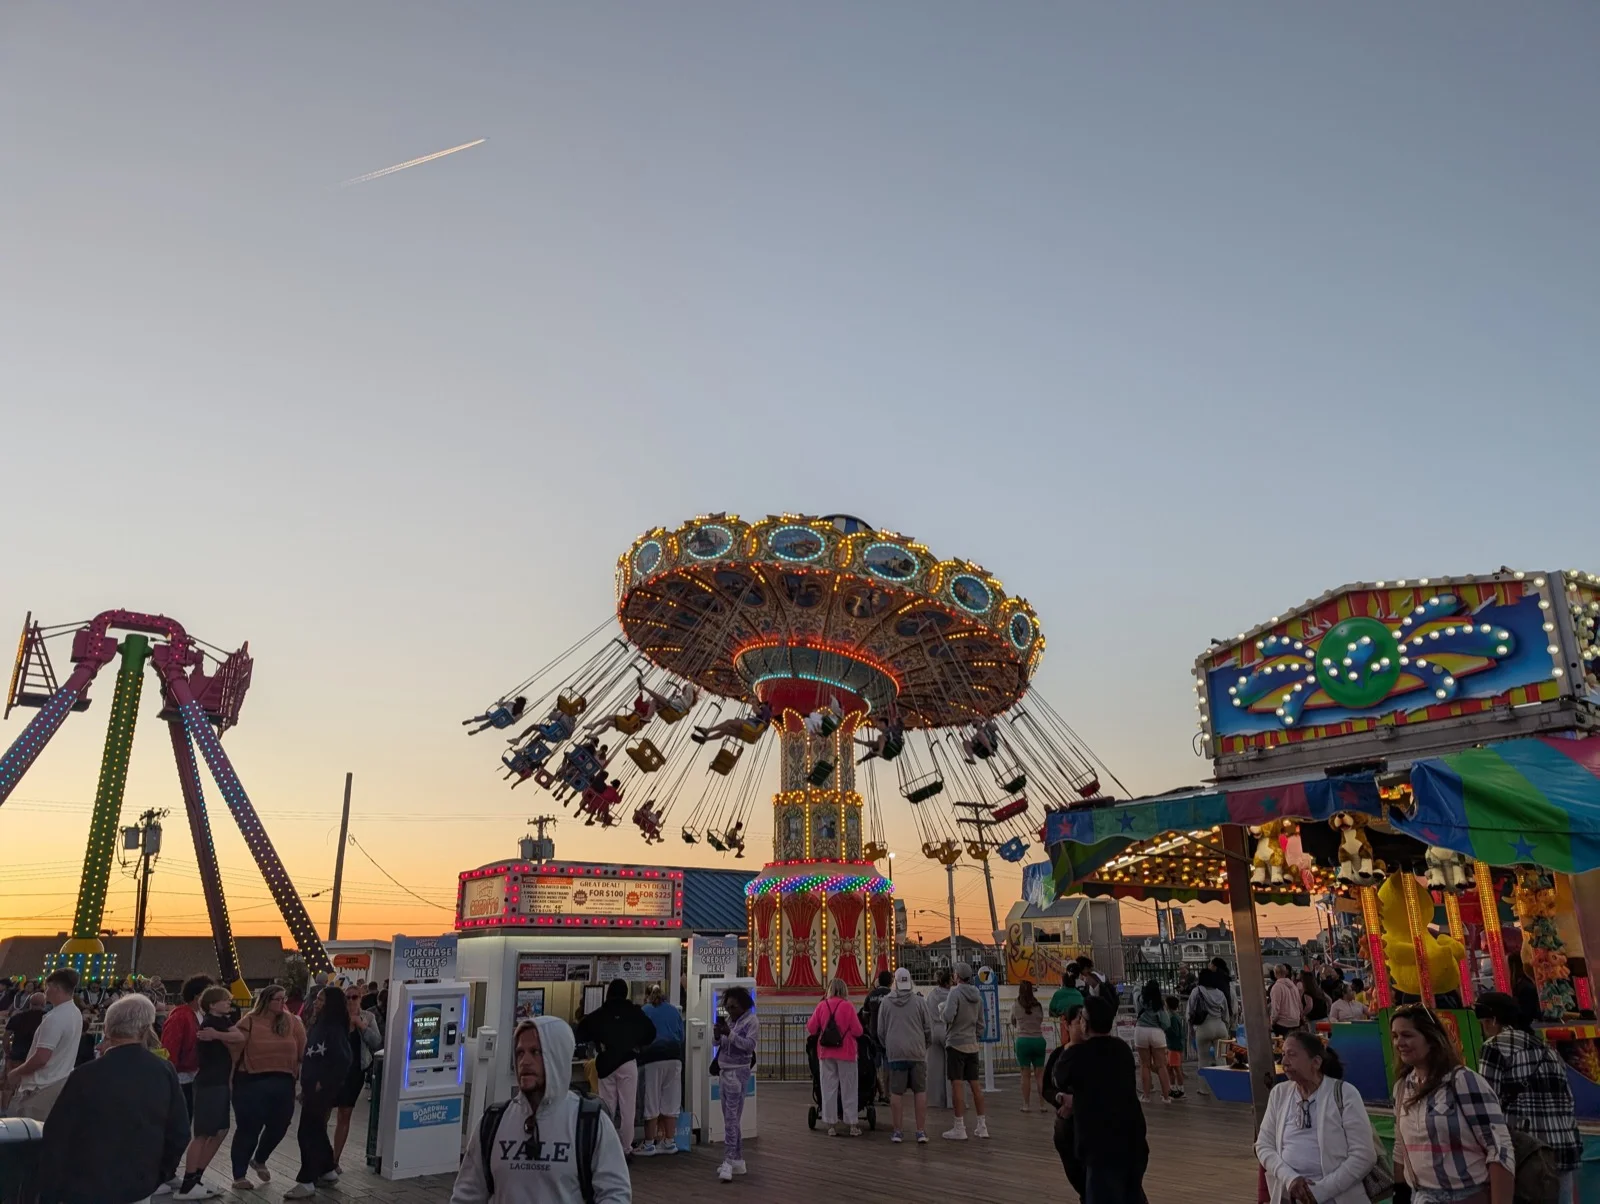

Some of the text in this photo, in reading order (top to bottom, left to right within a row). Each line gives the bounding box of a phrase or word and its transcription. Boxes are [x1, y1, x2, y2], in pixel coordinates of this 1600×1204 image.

[589, 889, 604, 897] FOR
[606, 890, 624, 898] $100
[654, 891, 671, 899] $225
[403, 947, 452, 958] PURCHASE
[699, 947, 734, 955] PURCHASE
[407, 958, 447, 968] CREDITS
[701, 956, 730, 964] CREDITS
[415, 968, 439, 978] HERE
[707, 964, 725, 972] HERE
[984, 970, 990, 980] 7
[413, 1104, 448, 1120] BOARDWALK
[419, 1111, 447, 1122] BOUNCE
[499, 1140, 570, 1162] YALE
[510, 1163, 551, 1171] LACROSSE
